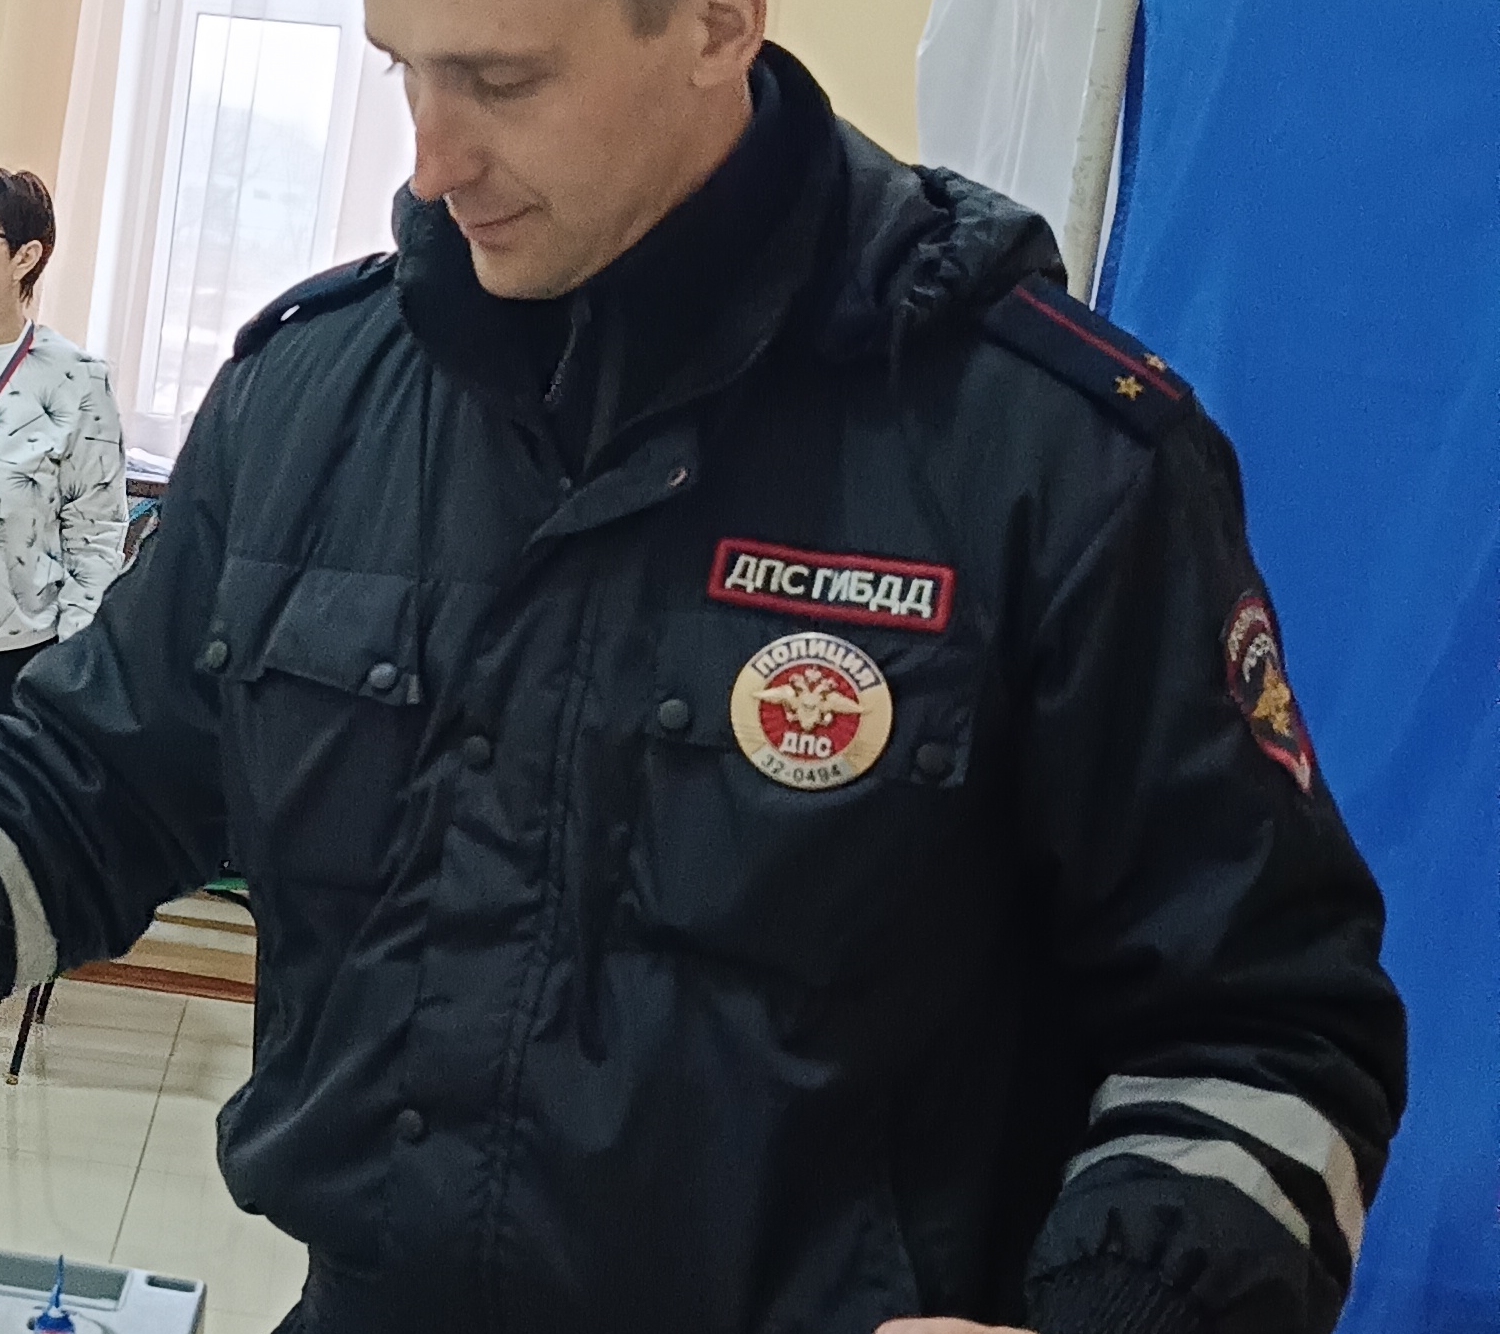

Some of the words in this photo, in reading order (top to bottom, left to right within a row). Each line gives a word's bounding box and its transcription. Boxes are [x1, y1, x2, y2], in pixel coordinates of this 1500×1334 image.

[725, 553, 809, 595] ДПС
[811, 567, 935, 618] ГИБДД
[754, 639, 877, 688] ПОЛИЦИЯ
[779, 731, 832, 758] ДПС
